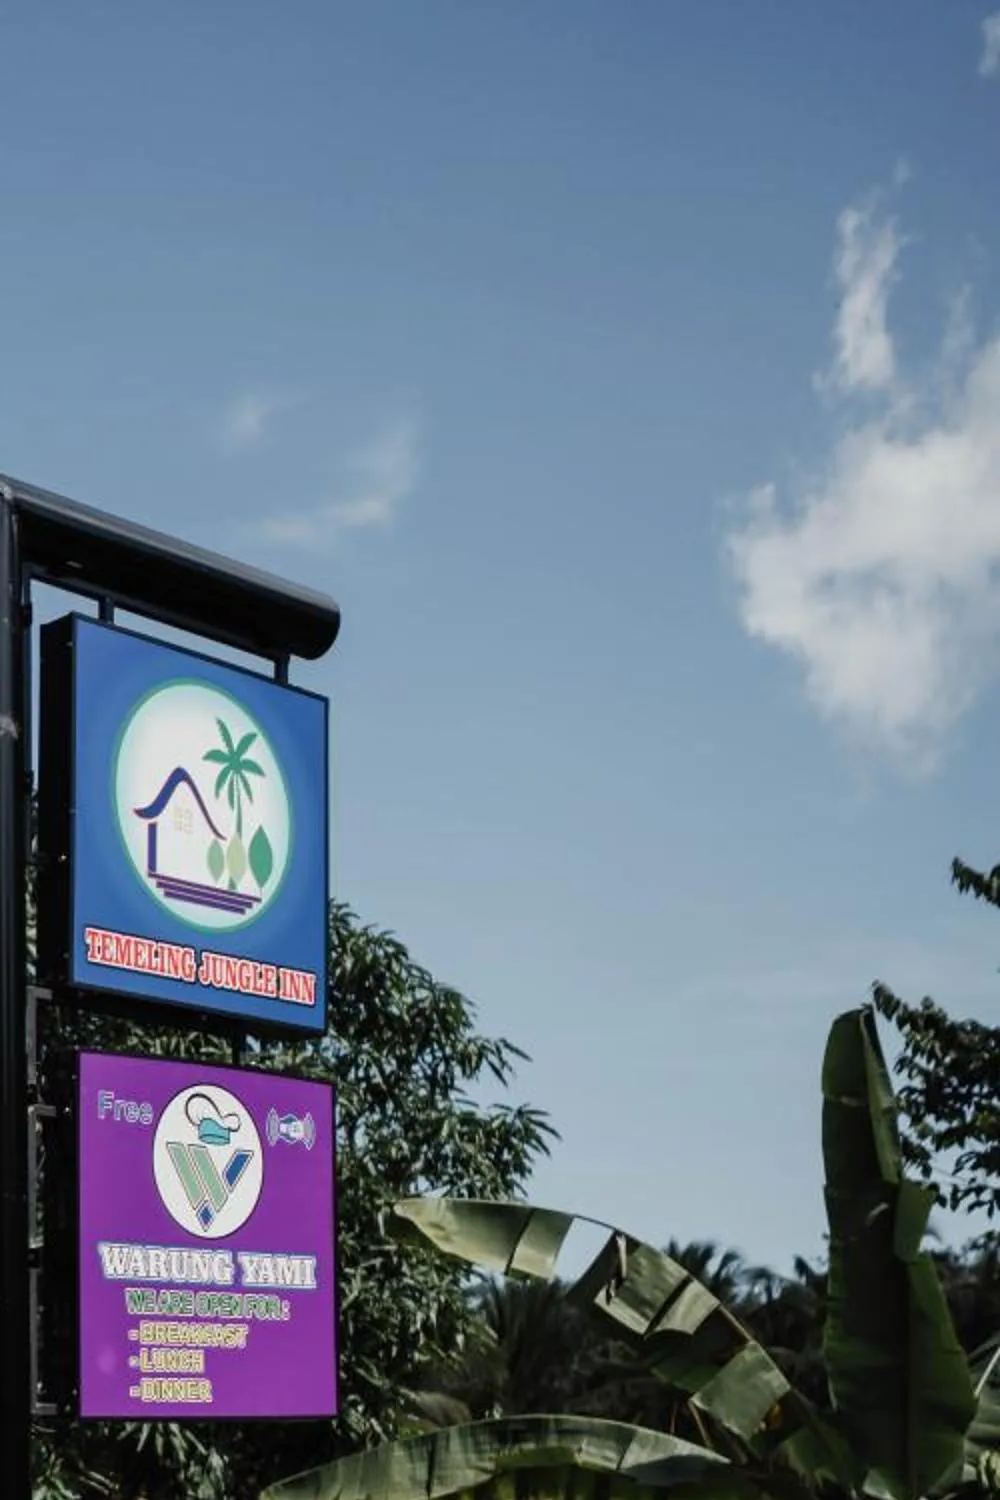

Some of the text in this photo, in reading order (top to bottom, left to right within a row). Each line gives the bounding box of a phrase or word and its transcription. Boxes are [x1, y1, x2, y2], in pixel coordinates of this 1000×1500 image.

[85, 927, 316, 1006] TEMELING JUNGLE INN
[97, 1088, 154, 1125] Free
[98, 1242, 317, 1288] WARUNG YAMI
[125, 1287, 155, 1316] WE
[158, 1289, 194, 1317] ARE
[196, 1290, 244, 1318] OPEN
